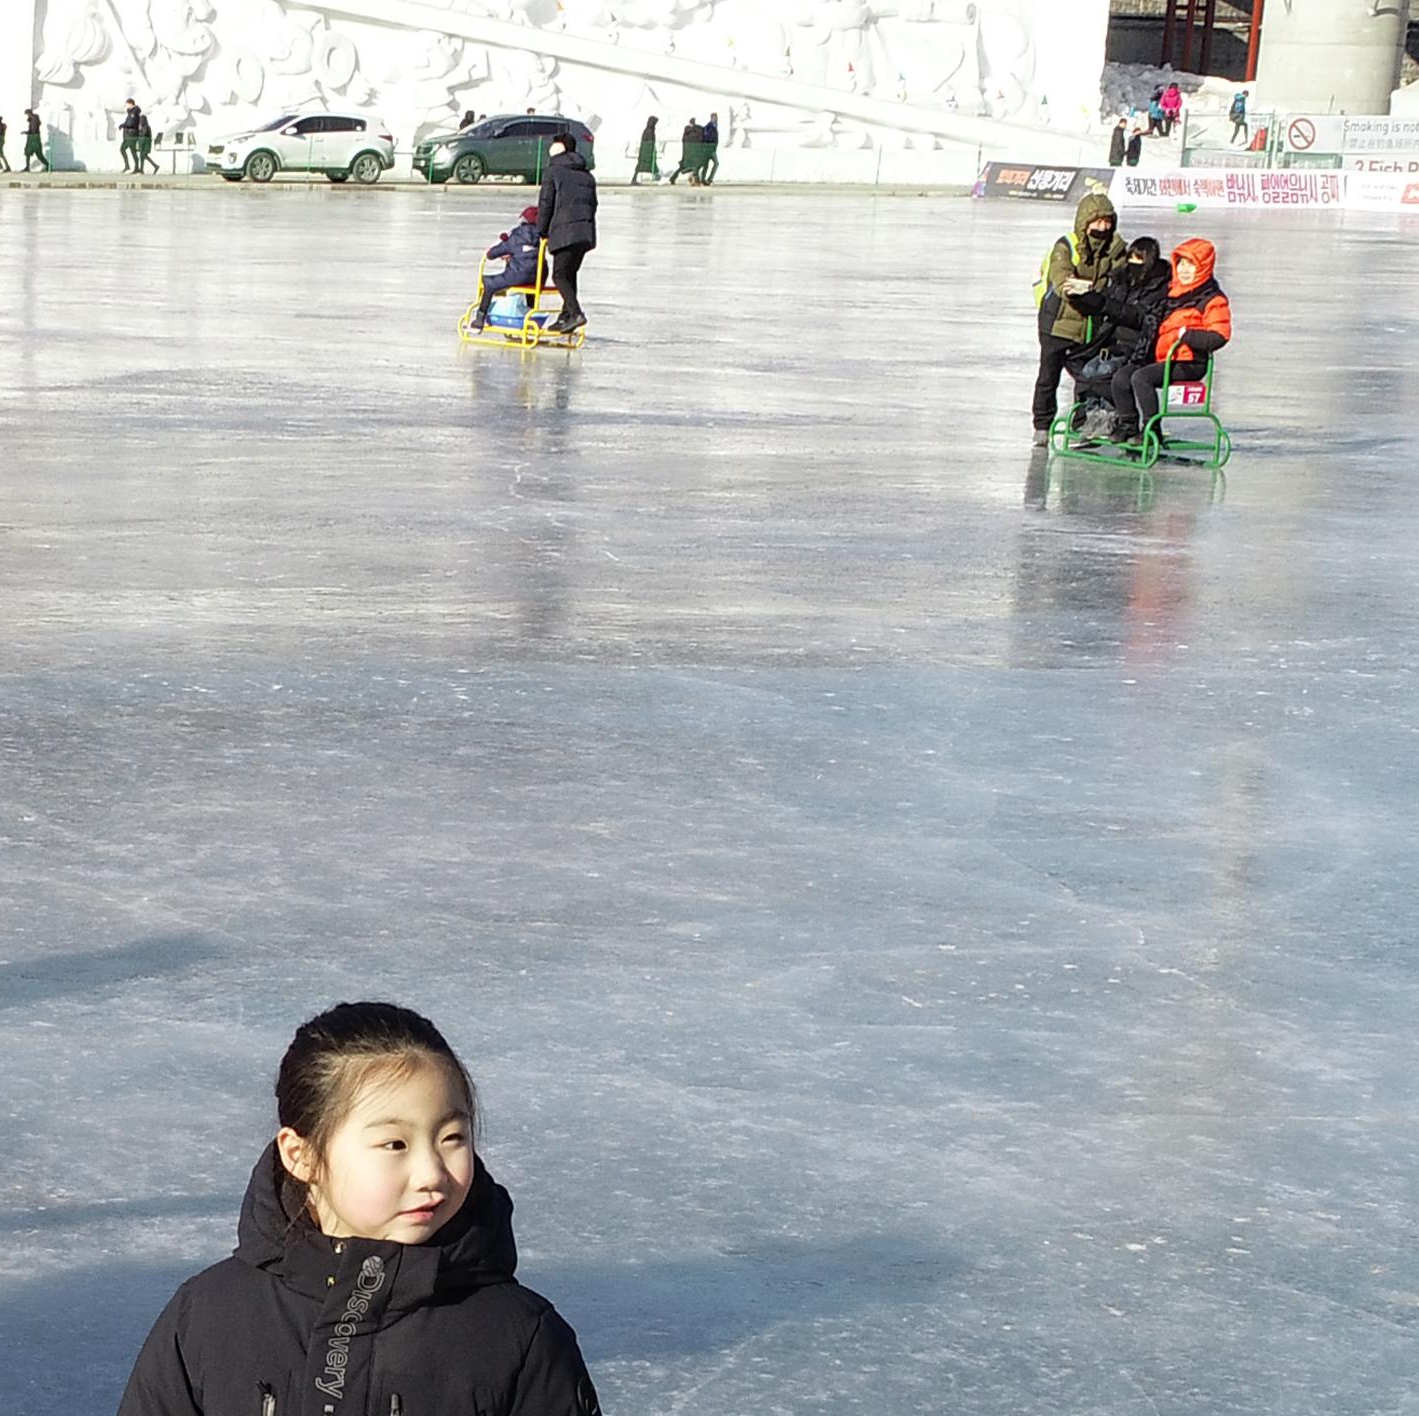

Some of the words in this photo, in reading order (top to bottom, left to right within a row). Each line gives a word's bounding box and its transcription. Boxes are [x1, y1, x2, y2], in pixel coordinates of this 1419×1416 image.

[1343, 119, 1389, 136] Smoking
[1391, 121, 1401, 133] is
[315, 1268, 387, 1400] Discovery
